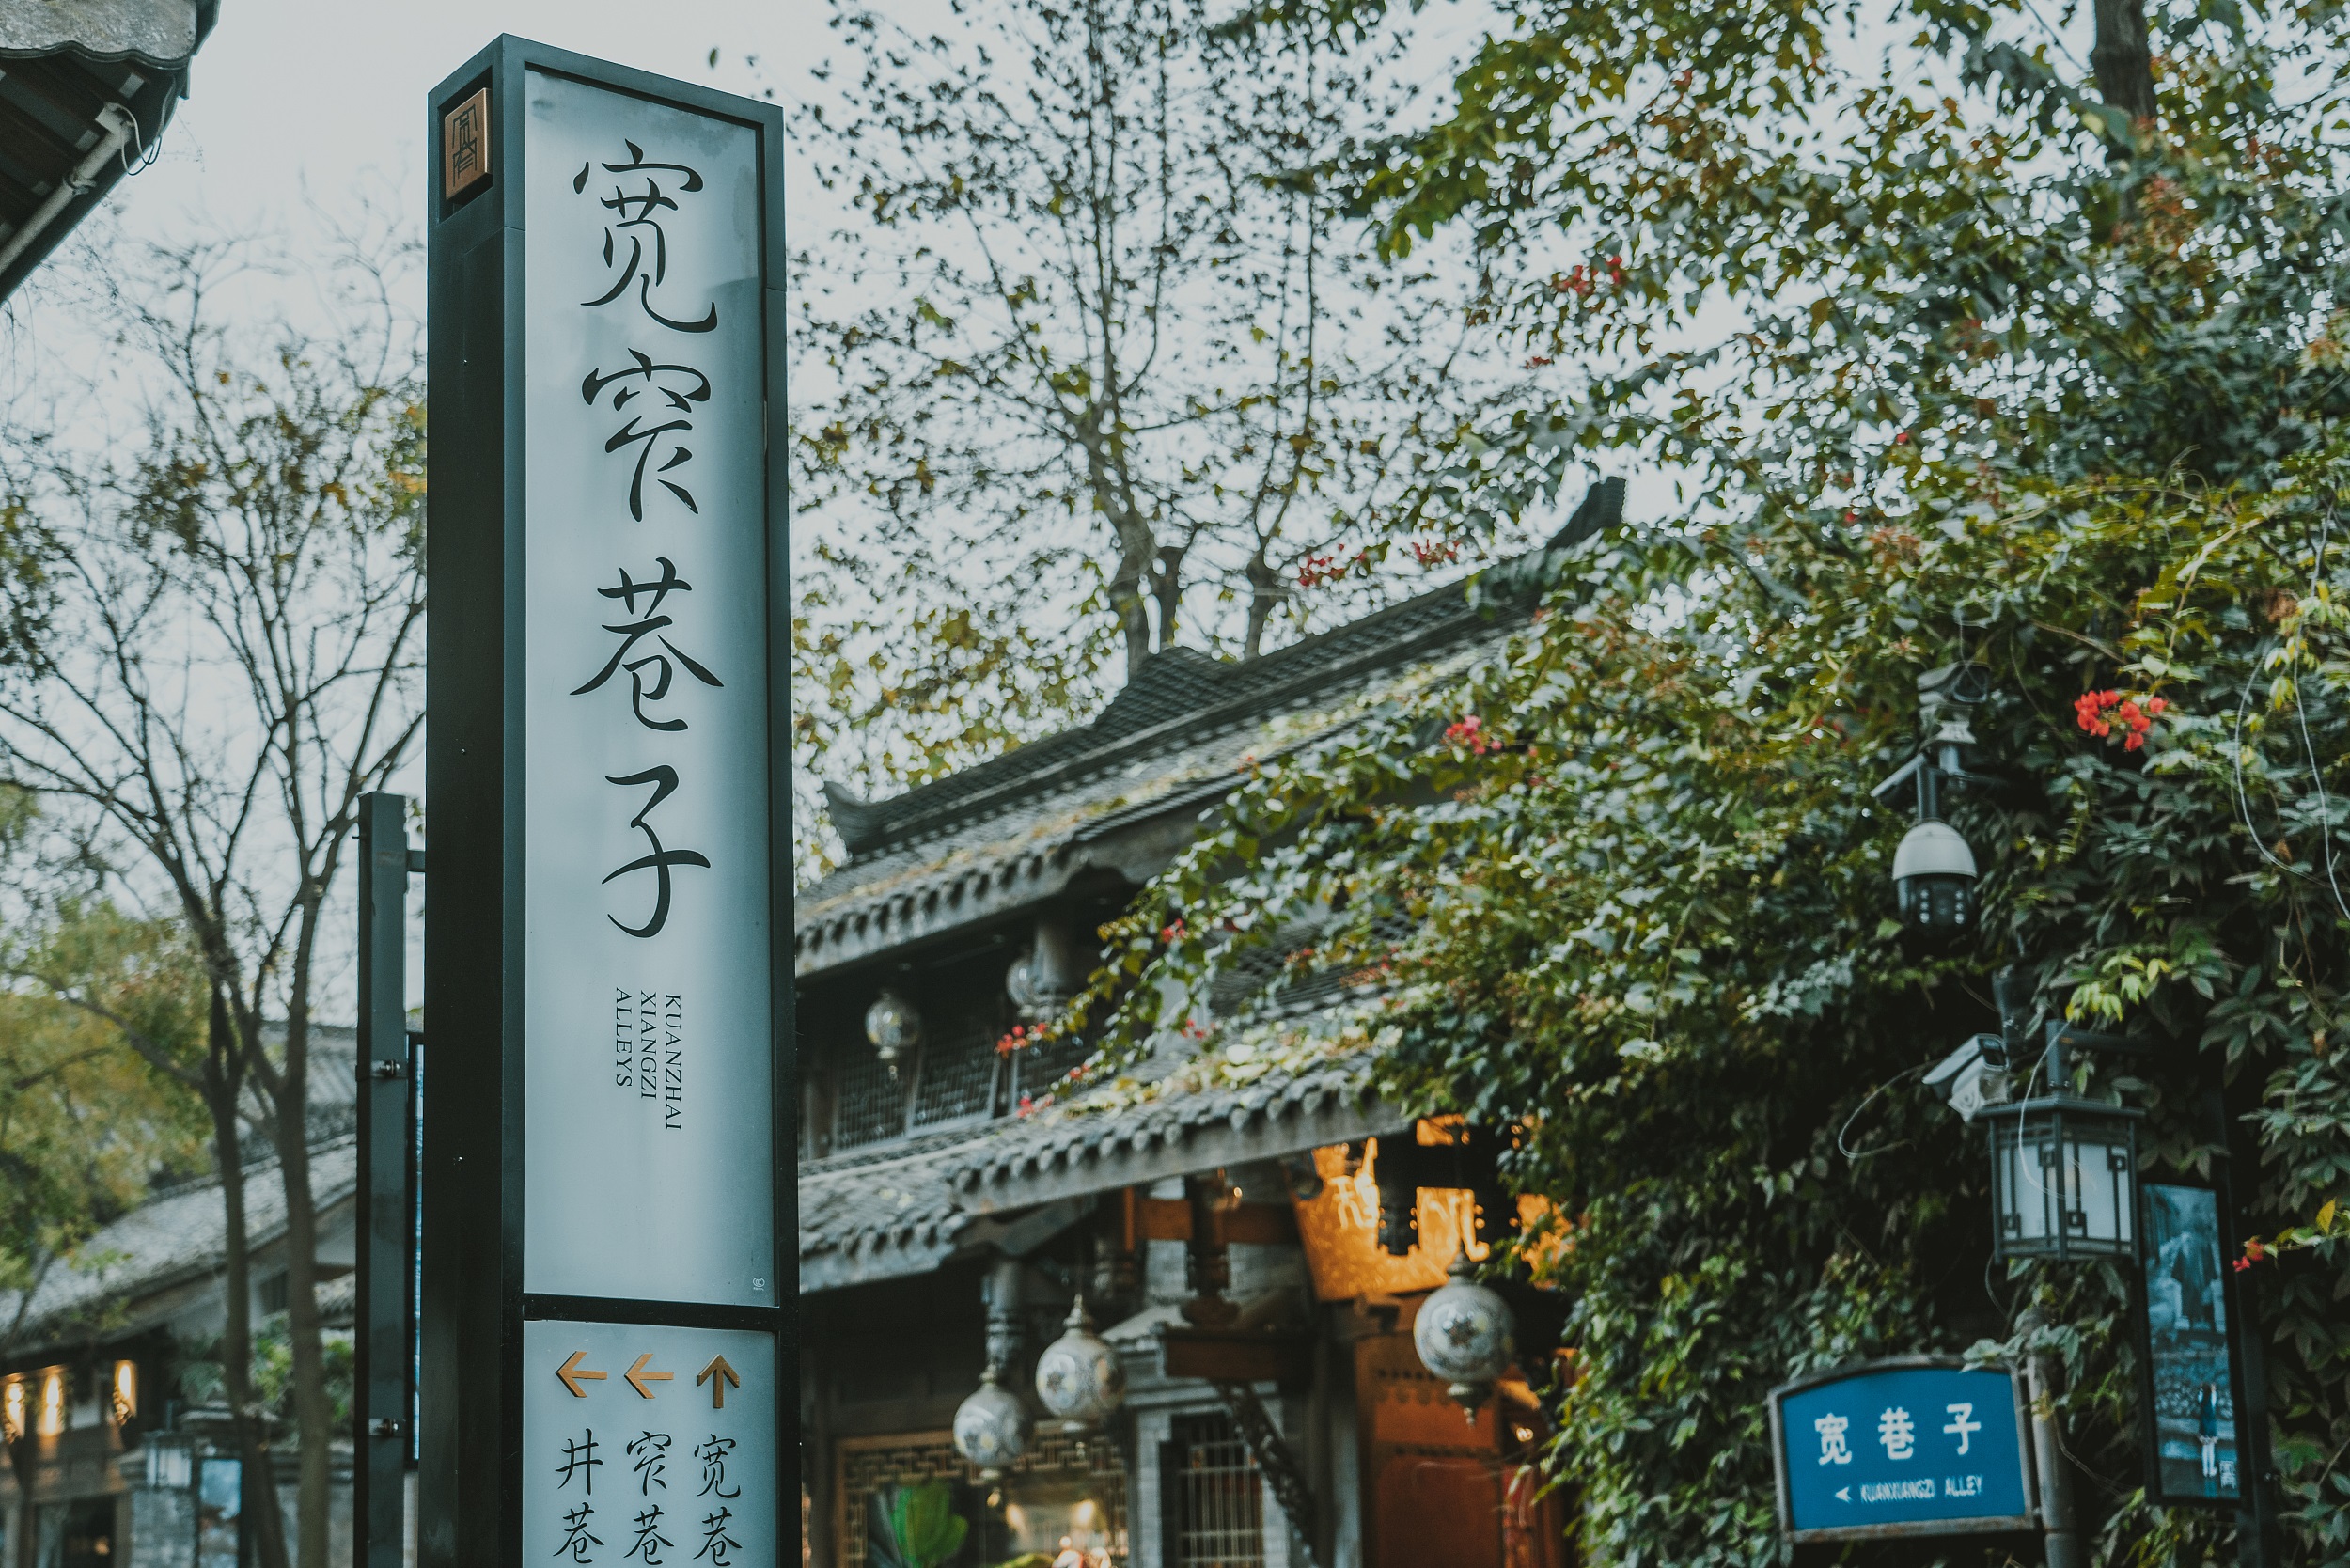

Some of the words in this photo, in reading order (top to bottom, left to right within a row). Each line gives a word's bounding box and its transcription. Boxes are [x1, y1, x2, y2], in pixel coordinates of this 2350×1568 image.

[570, 138, 724, 938] 宽窄巷子
[616, 987, 633, 1087] ALLEYS
[641, 990, 657, 1100] XIANGZI
[666, 993, 682, 1131] KUANZHAI
[553, 1428, 605, 1564] 井巷
[624, 1431, 675, 1565] 窄巷
[693, 1434, 743, 1567] 宽巷
[1814, 1402, 1982, 1466] 宽巷子
[1945, 1475, 1982, 1497] ALLEY
